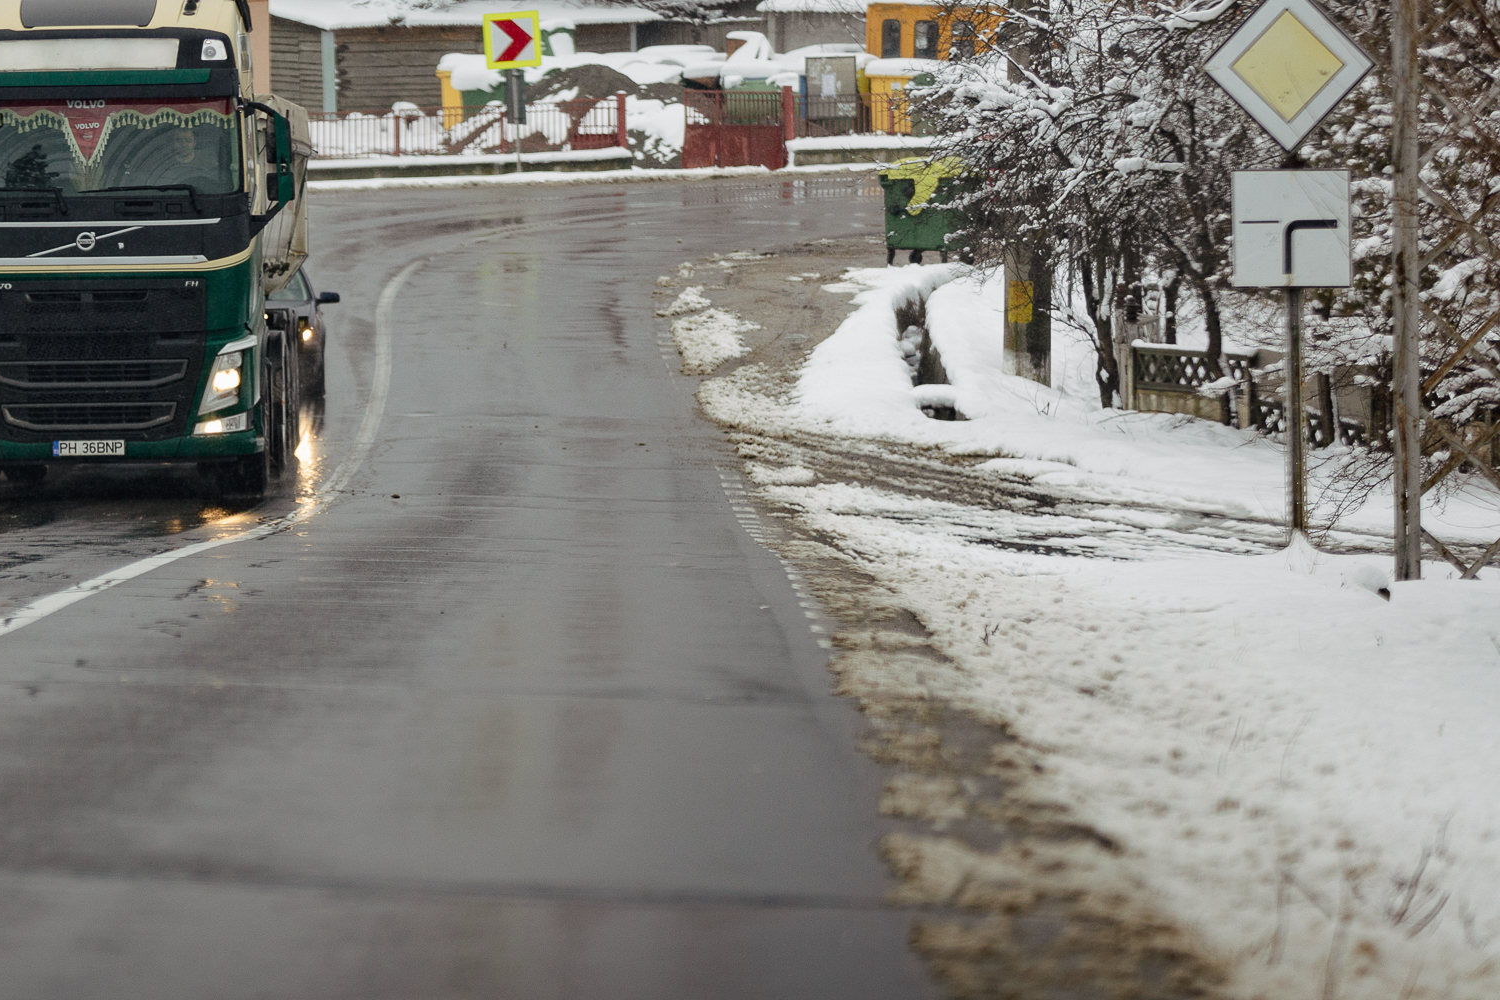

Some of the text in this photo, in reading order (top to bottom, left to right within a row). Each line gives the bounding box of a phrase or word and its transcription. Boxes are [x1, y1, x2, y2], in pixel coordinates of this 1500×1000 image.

[66, 99, 106, 109] VOLVO
[74, 122, 100, 130] VOLVO
[59, 442, 77, 454] PH
